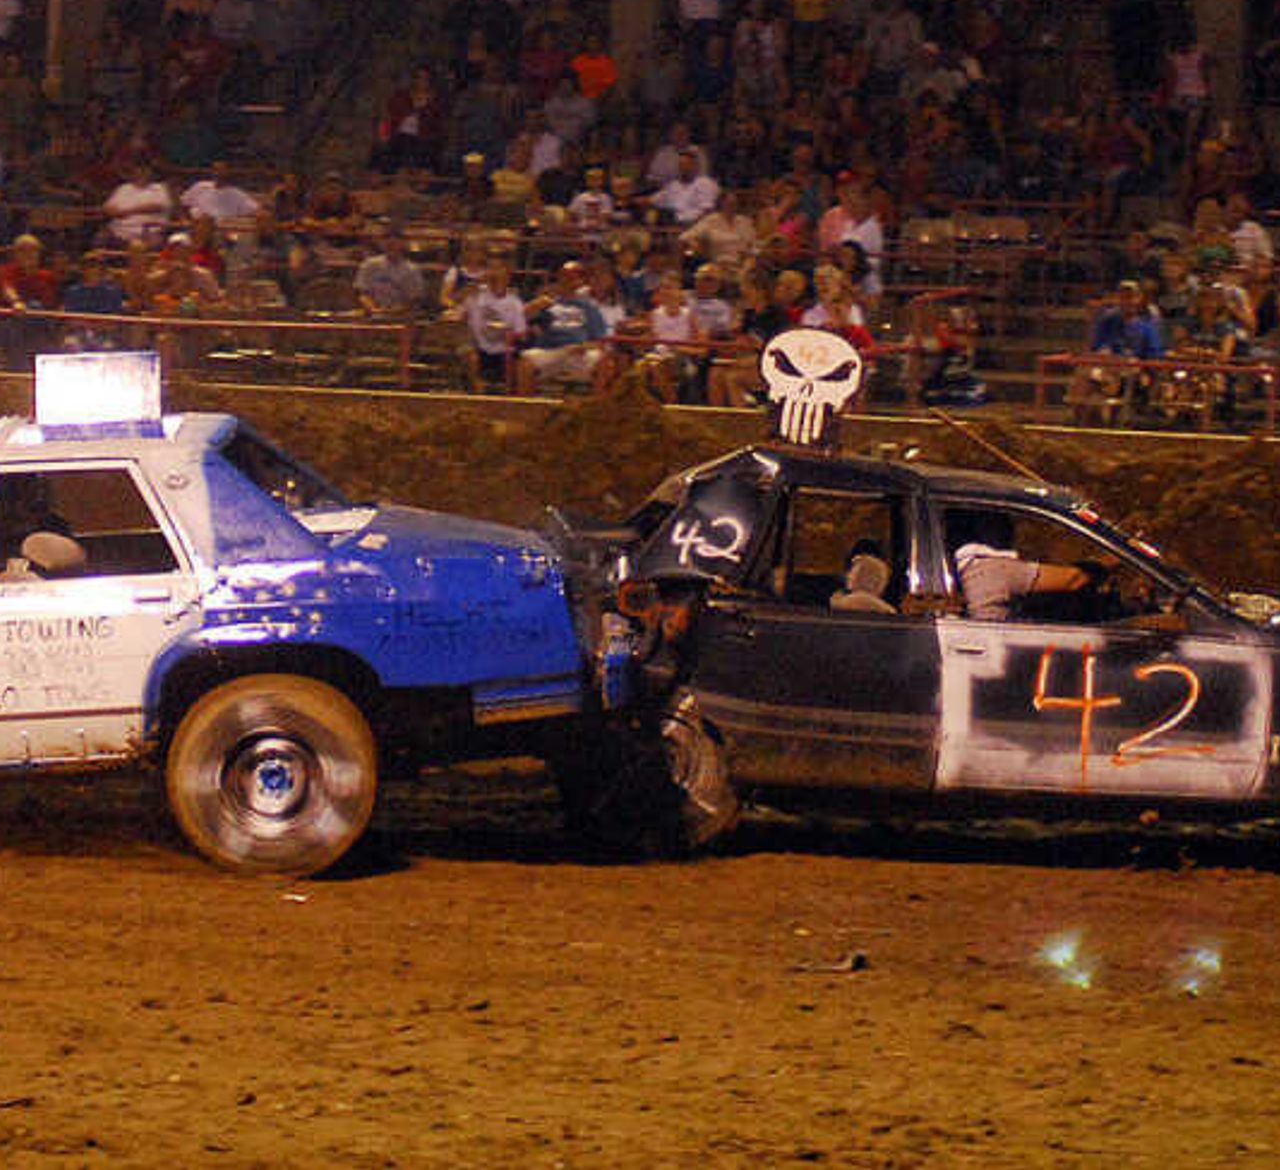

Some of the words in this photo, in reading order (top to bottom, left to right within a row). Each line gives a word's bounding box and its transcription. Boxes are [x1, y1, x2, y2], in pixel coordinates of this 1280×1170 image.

[672, 517, 743, 565] 42
[3, 615, 115, 643] TOWING
[1033, 642, 1218, 792] 42
